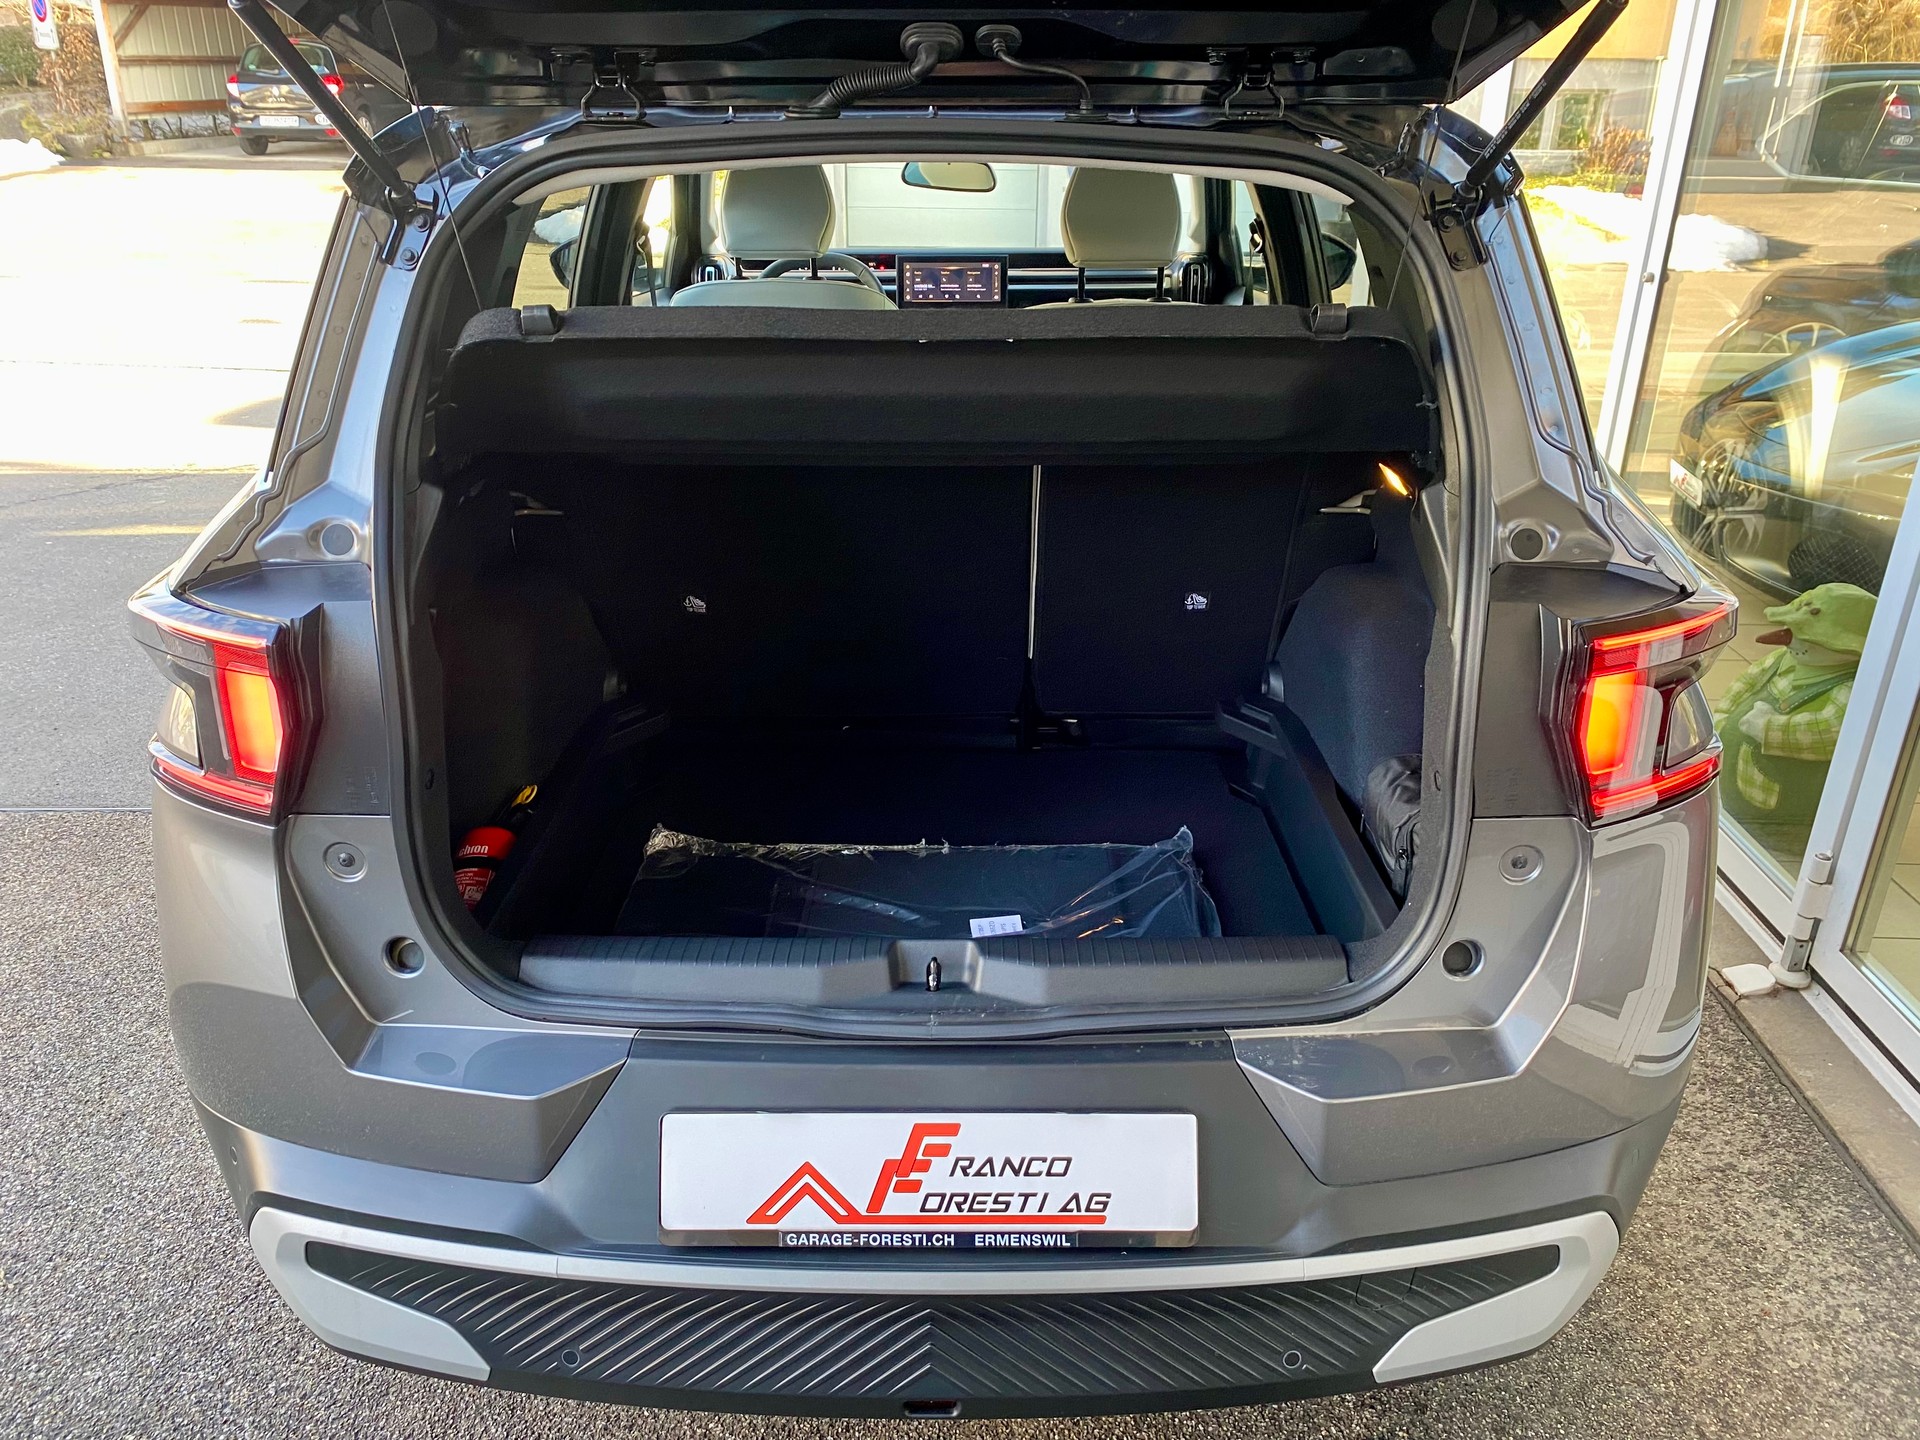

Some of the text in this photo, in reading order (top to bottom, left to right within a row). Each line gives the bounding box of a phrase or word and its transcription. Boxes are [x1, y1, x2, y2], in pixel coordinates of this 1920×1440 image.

[1057, 1192, 1112, 1214] AG
[786, 1232, 1071, 1248] GARAGE-FORESTI.CH ERMENSWIL
